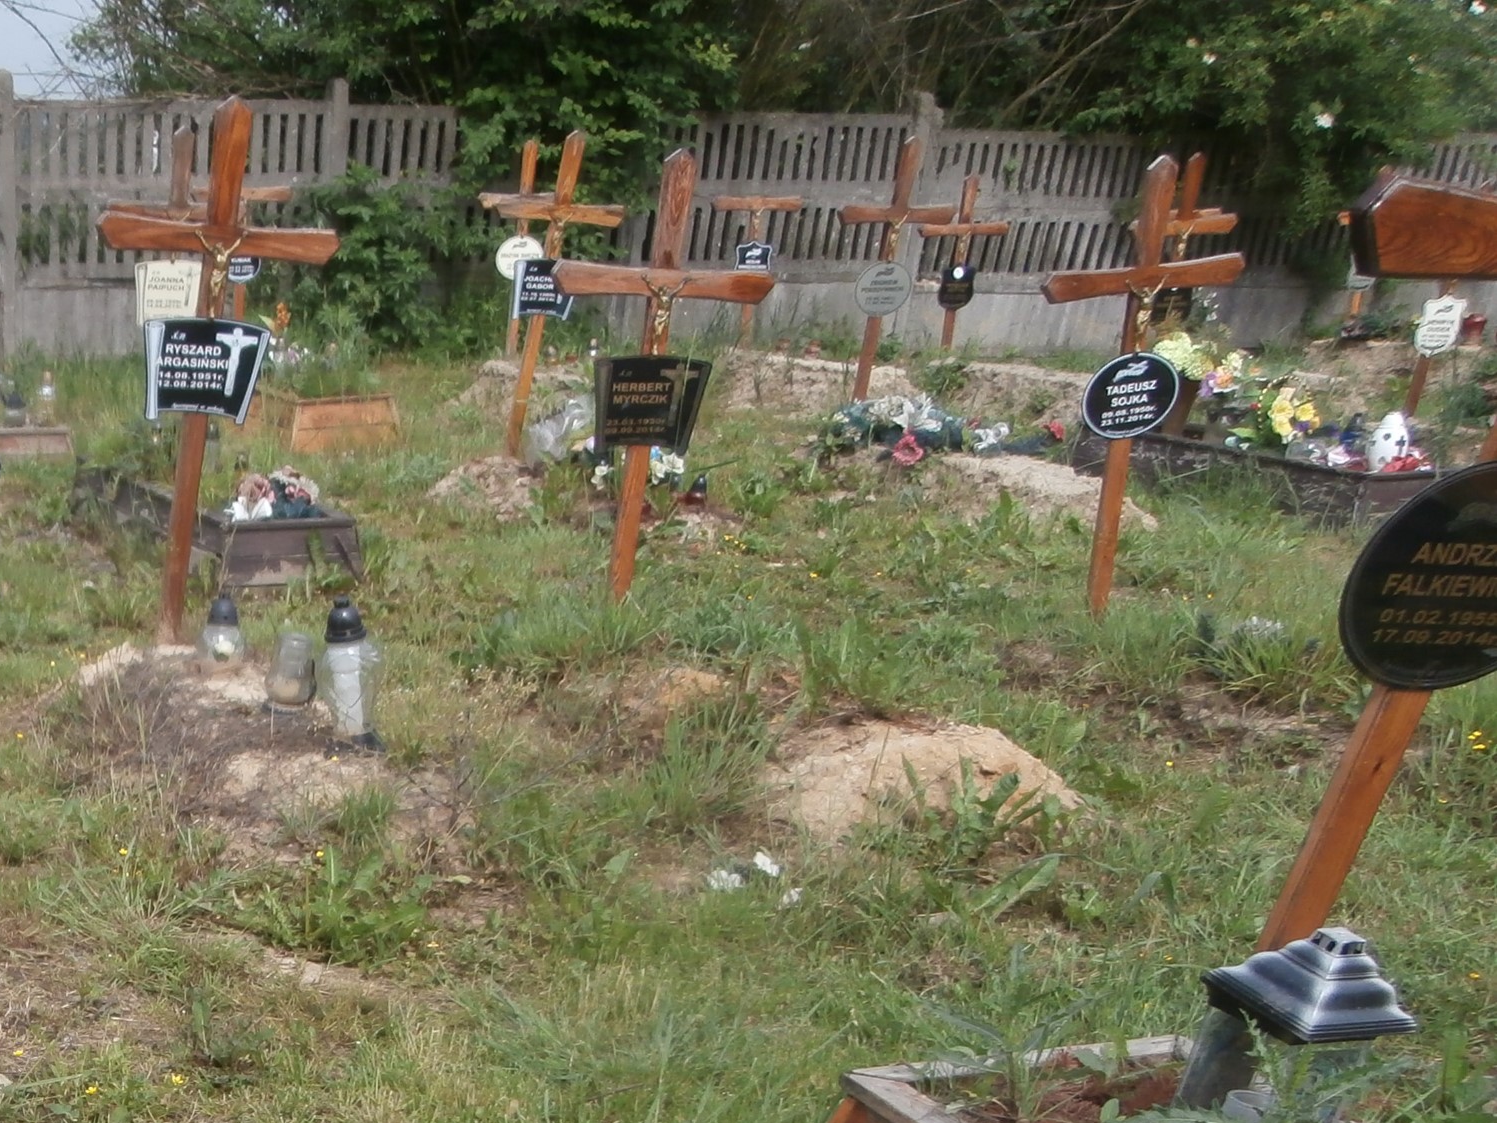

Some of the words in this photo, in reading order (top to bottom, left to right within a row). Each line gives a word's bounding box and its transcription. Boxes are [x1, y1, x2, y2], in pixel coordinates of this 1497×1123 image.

[165, 343, 222, 356] RYSZARD
[612, 382, 671, 393] HERBERT
[1106, 380, 1158, 396] TADEUSZ
[612, 394, 668, 405] MYRCZIK
[1111, 394, 1149, 407] SOJKA
